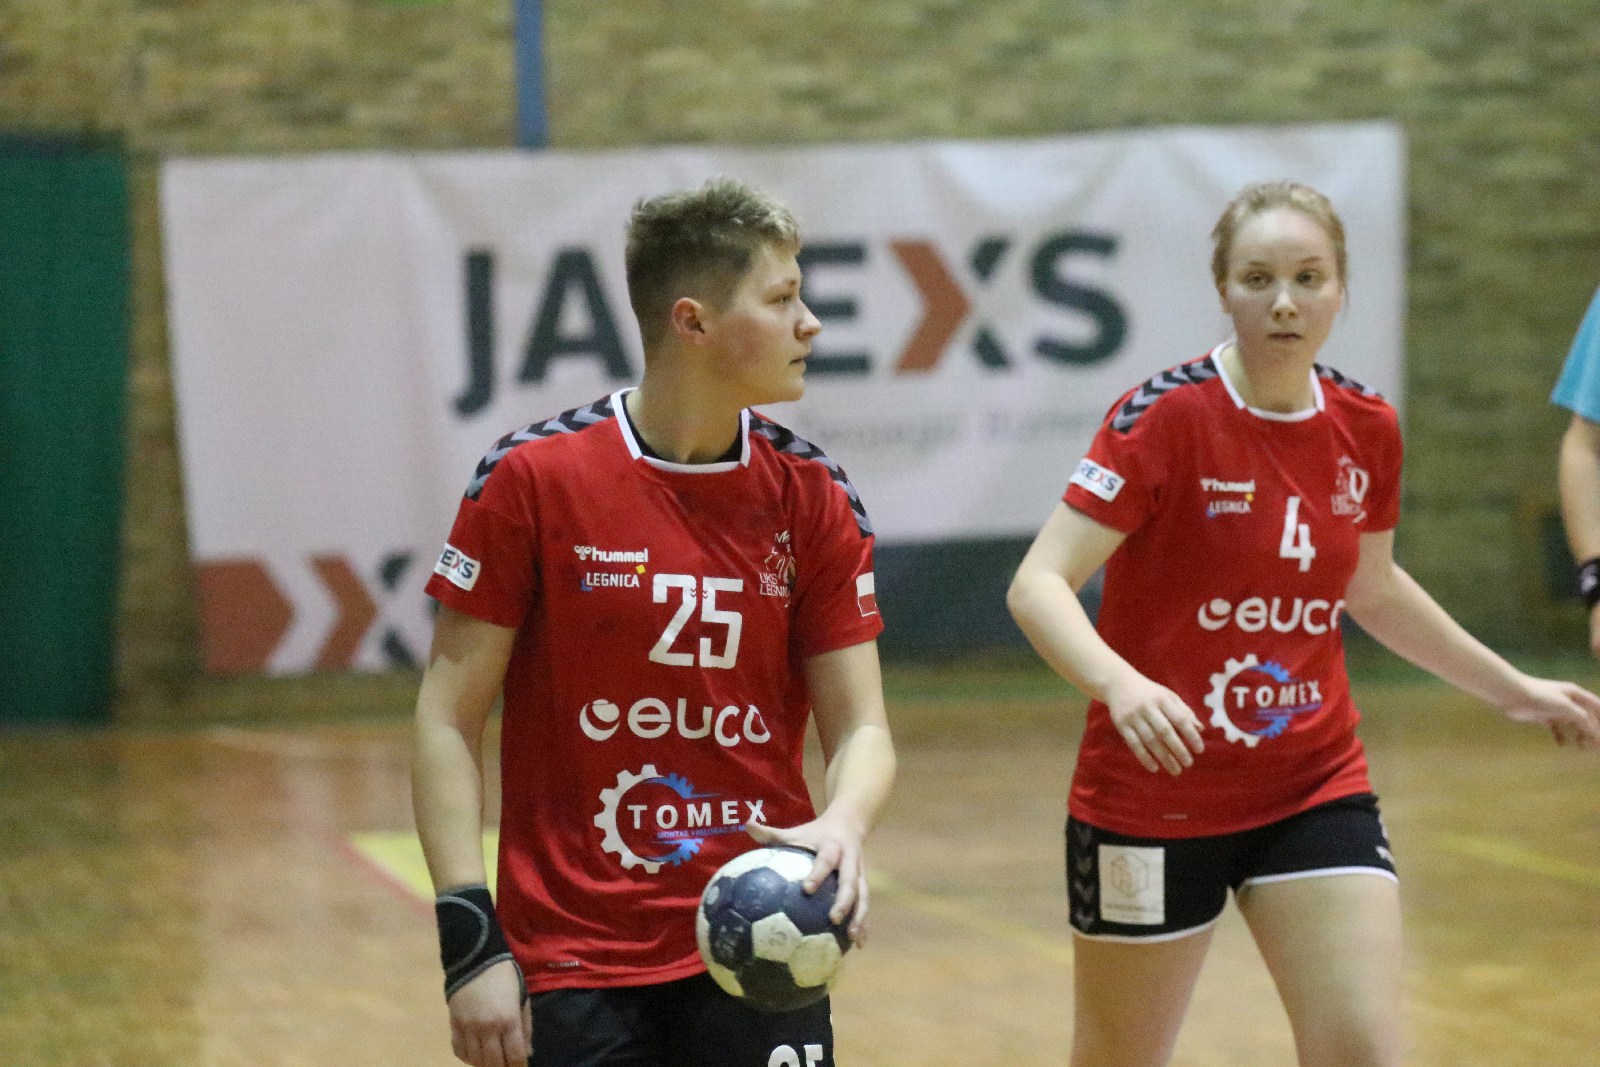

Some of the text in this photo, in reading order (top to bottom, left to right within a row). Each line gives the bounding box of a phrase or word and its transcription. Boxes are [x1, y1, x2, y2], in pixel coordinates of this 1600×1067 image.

[453, 226, 1131, 417] JAEXS
[1279, 496, 1316, 572] 4
[592, 546, 649, 563] hummel
[586, 572, 640, 588] LEGNICA
[759, 572, 778, 584] UKS
[760, 583, 791, 598] LEGNIC
[648, 573, 744, 670] 25
[1231, 680, 1323, 709] TOMEX
[627, 799, 767, 830] TOMEX
